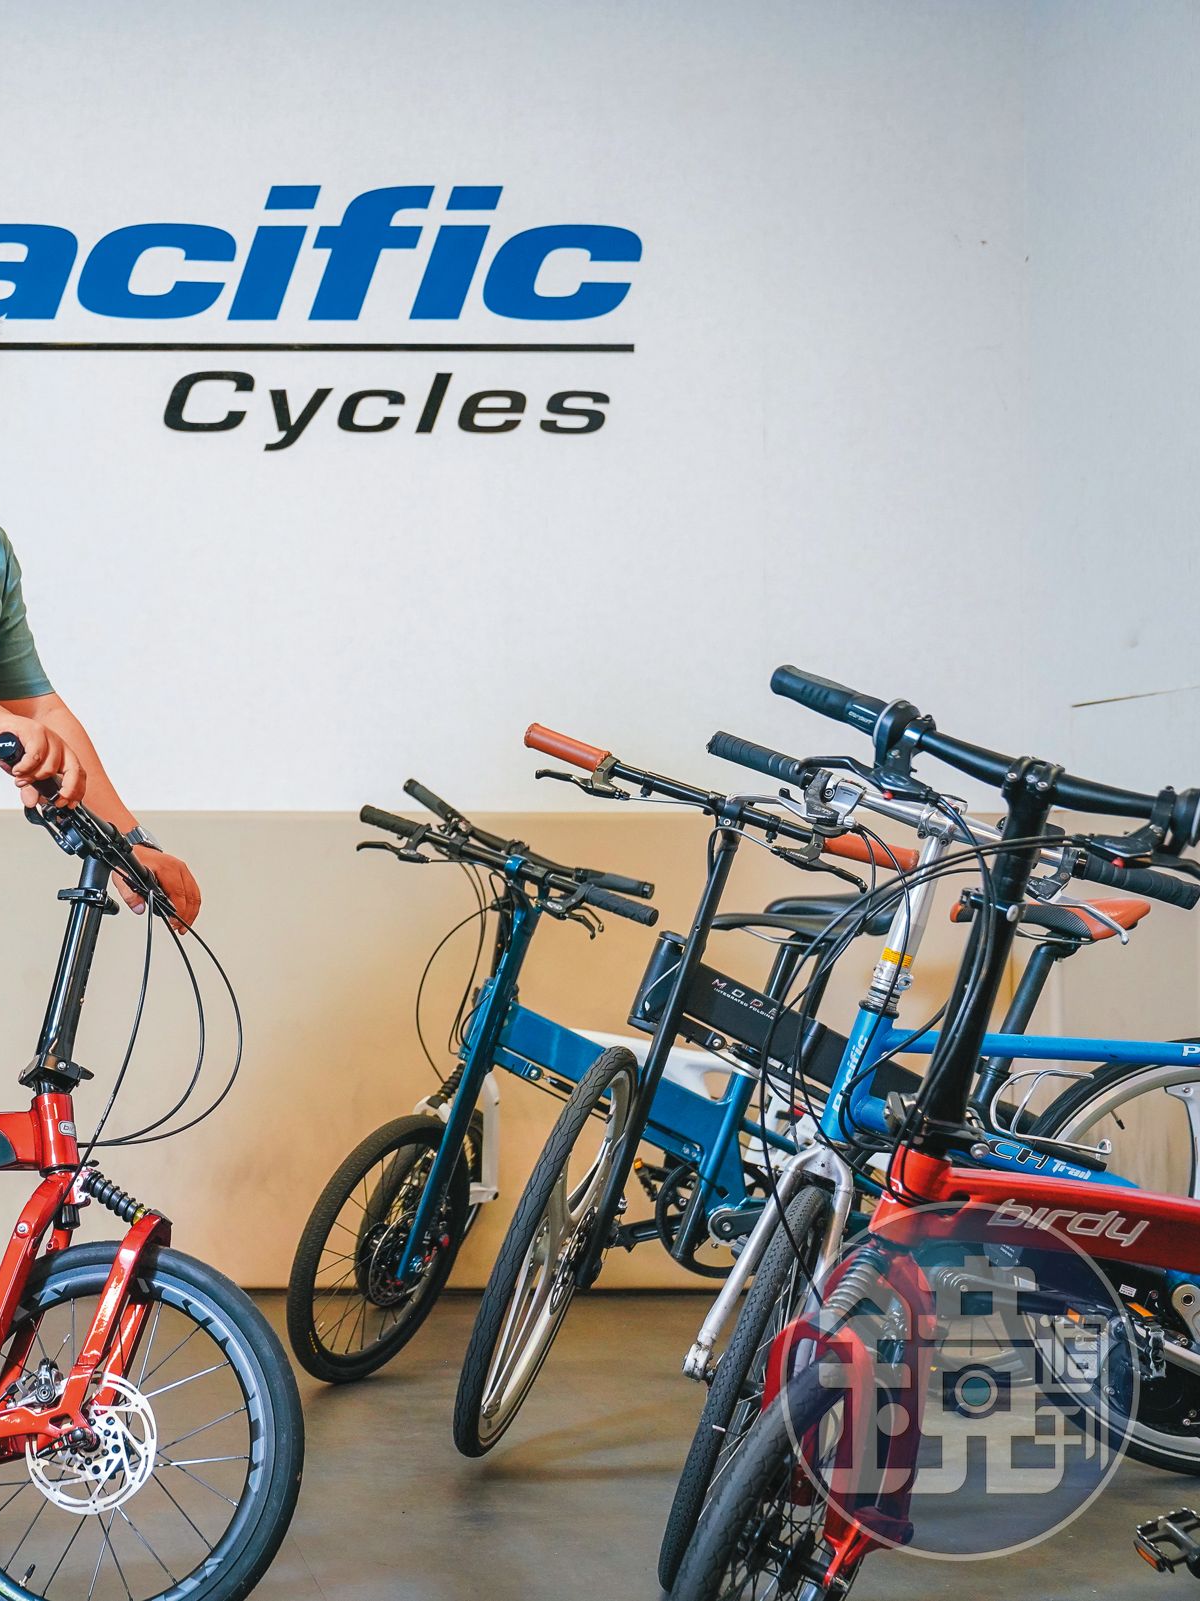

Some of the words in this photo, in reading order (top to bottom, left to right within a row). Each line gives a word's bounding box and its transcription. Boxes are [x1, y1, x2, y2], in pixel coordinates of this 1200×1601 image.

[163, 370, 611, 453] Cycles
[1052, 1158, 1092, 1181] Trail
[987, 1198, 1150, 1248] birdy
